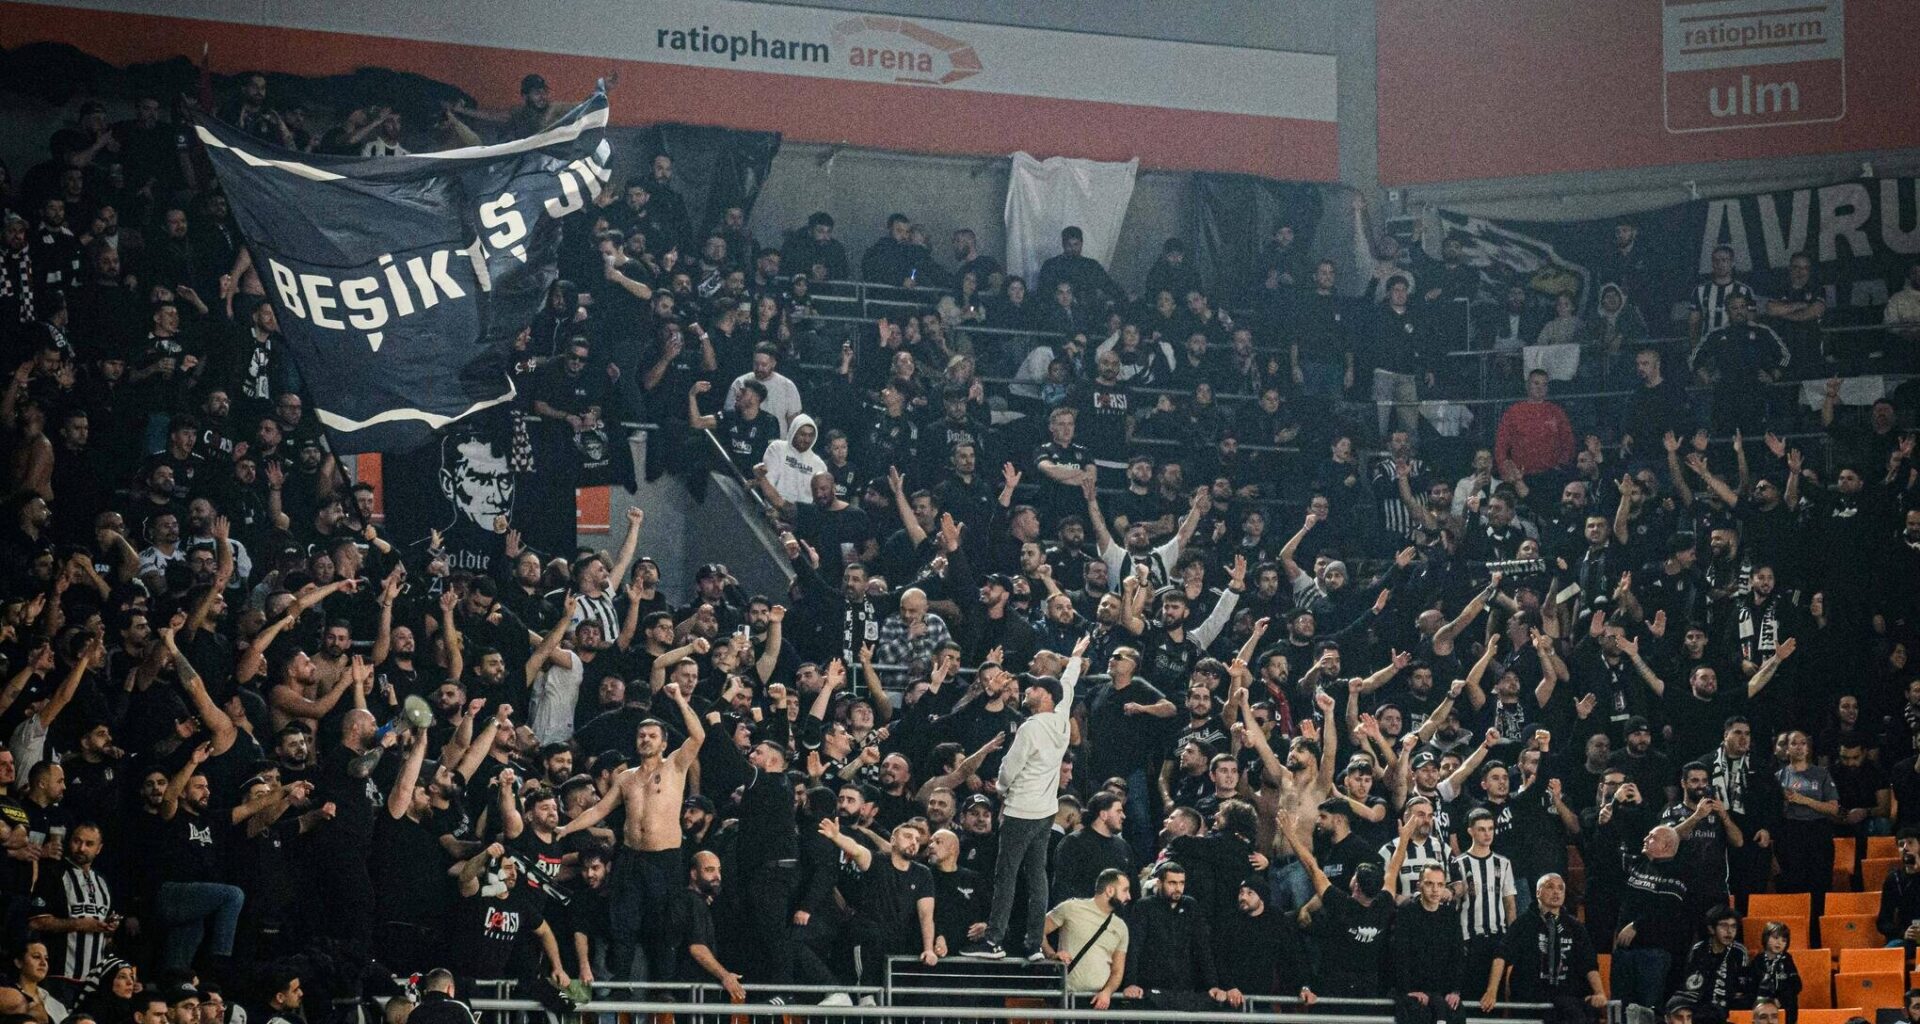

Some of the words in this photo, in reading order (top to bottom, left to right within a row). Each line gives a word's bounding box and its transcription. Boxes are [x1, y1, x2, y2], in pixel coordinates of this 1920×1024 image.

[657, 26, 829, 63] ratiopharm
[850, 45, 933, 73] arena
[1685, 20, 1822, 47] ratiopharm
[1709, 75, 1798, 116] ulm
[269, 192, 528, 352] BEŞİKTŞ
[447, 549, 490, 570] oldie
